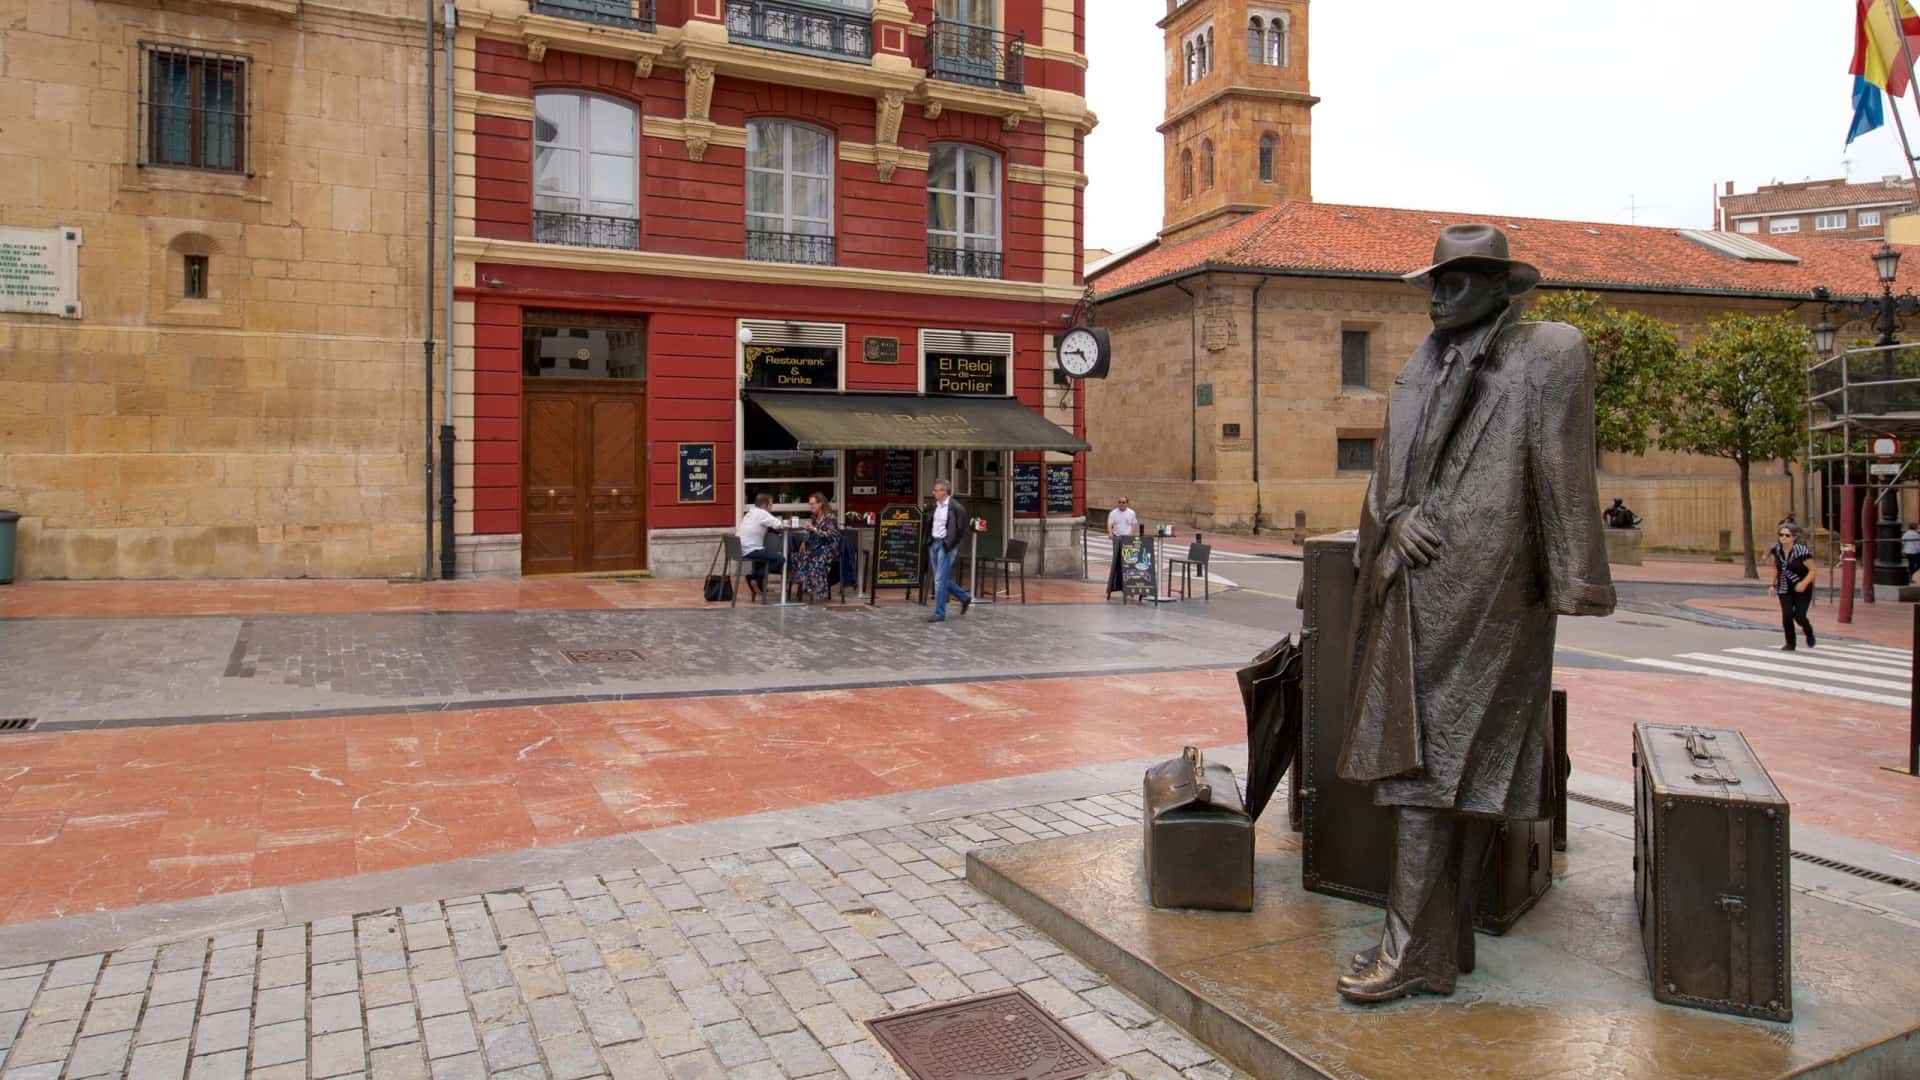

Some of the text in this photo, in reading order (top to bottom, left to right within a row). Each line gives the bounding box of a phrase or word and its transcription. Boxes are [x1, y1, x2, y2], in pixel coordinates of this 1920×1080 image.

[765, 355, 825, 366] Restaurant
[790, 366, 800, 376] &
[939, 358, 993, 375] El Reloj
[958, 369, 969, 378] de
[778, 375, 813, 385] Drinks
[939, 378, 993, 392] Porlier
